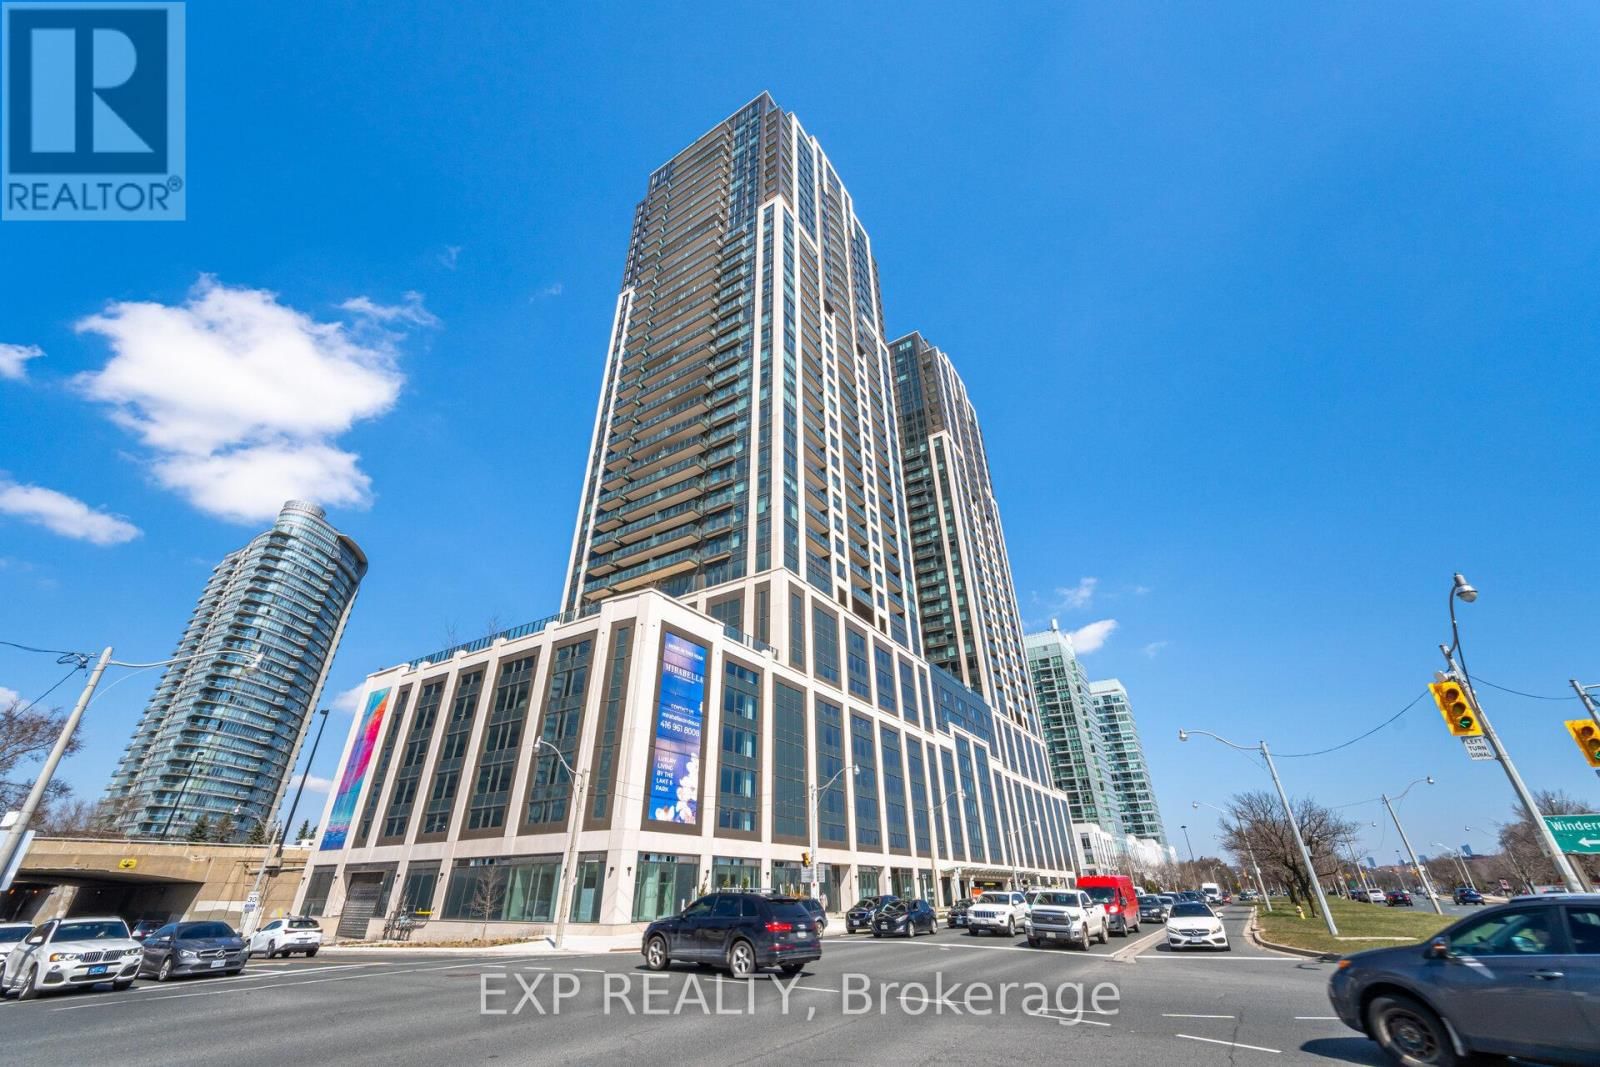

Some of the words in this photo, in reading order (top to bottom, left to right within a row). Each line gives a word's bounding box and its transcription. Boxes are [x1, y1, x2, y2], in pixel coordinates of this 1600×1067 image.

[665, 663, 704, 684] MIRABELLA
[660, 719, 672, 730] 416
[672, 723, 683, 733] 961
[658, 755, 676, 764] LUXURY
[657, 762, 673, 771] LIVING
[664, 771, 674, 779] THE
[655, 785, 669, 793] PARK
[1552, 820, 1600, 831] Winder
